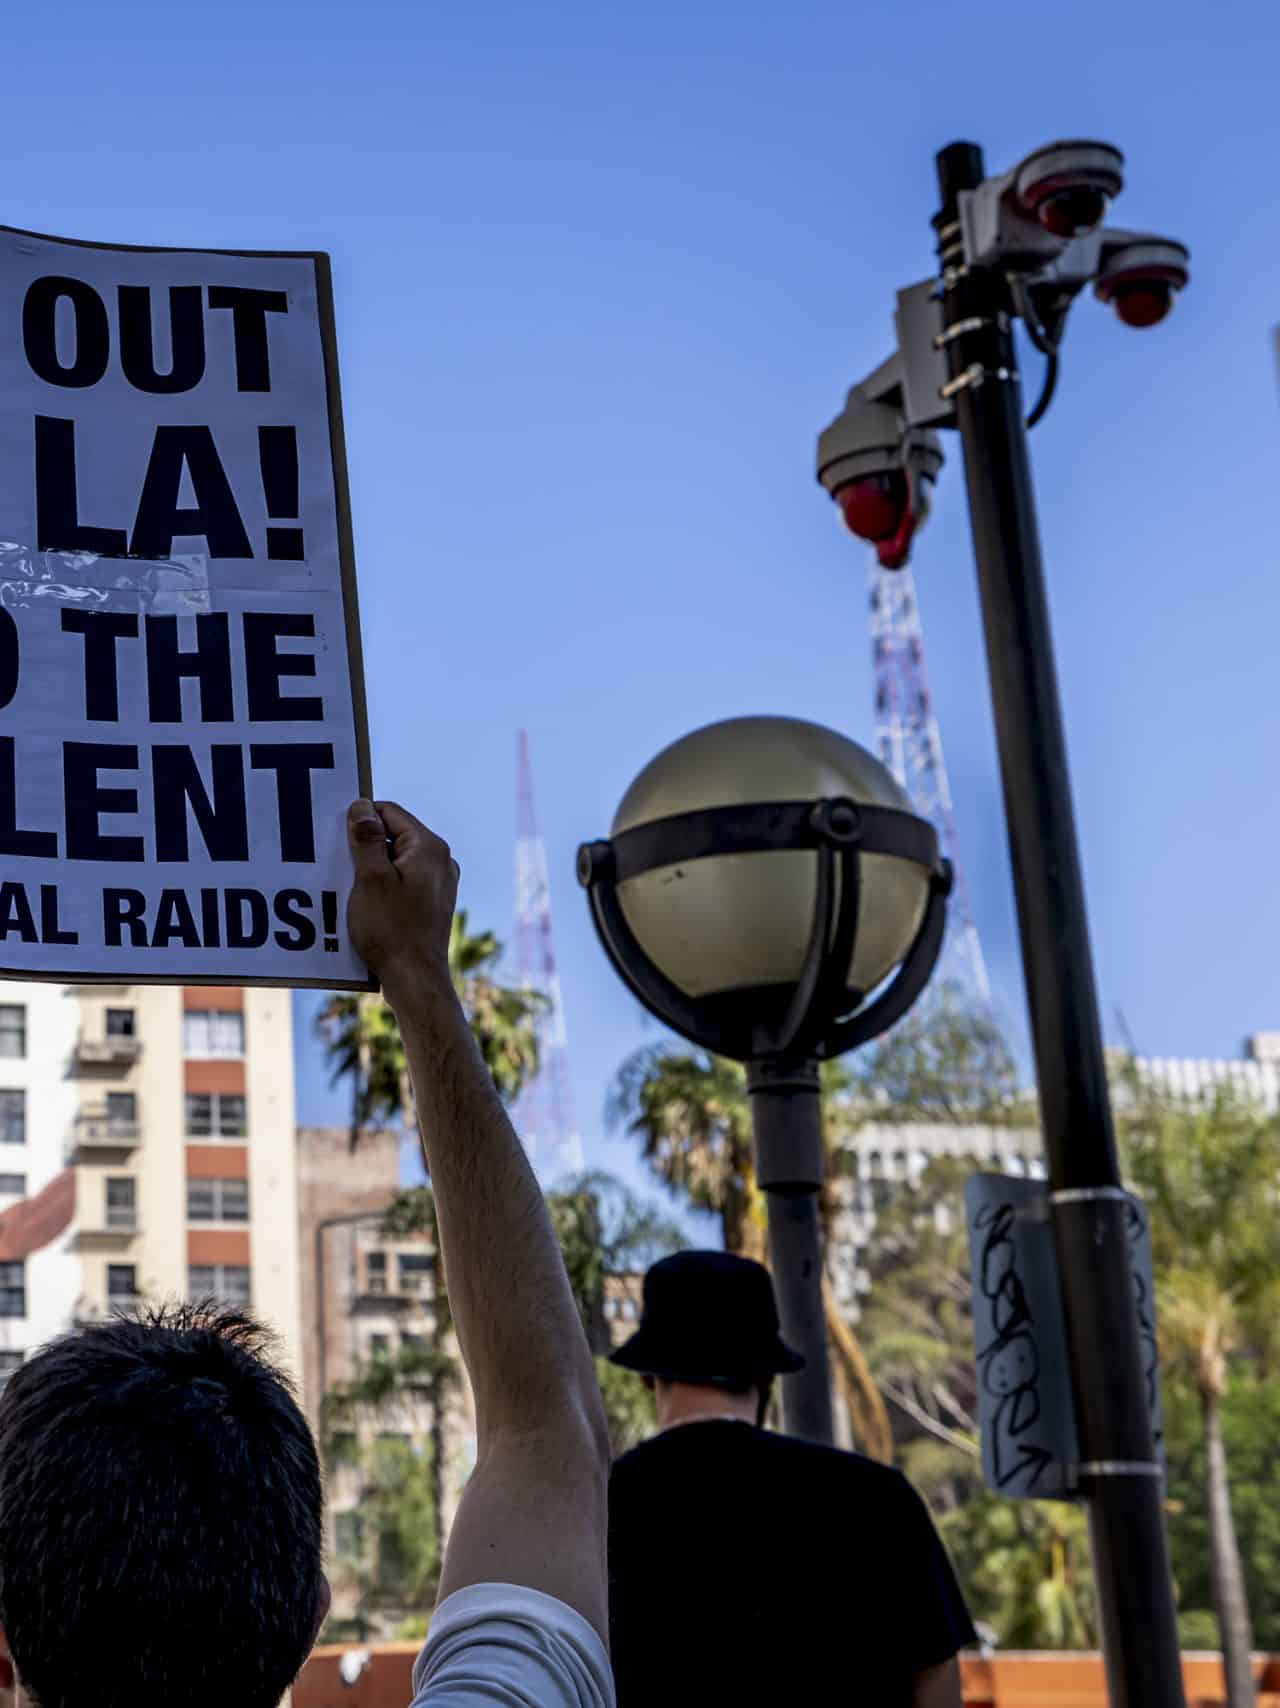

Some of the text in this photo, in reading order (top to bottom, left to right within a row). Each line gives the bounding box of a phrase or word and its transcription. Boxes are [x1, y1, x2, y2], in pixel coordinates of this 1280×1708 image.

[22, 275, 289, 394] OUT
[34, 415, 305, 561] LA!
[60, 607, 324, 723] THE
[103, 887, 340, 953] RAIDS!
